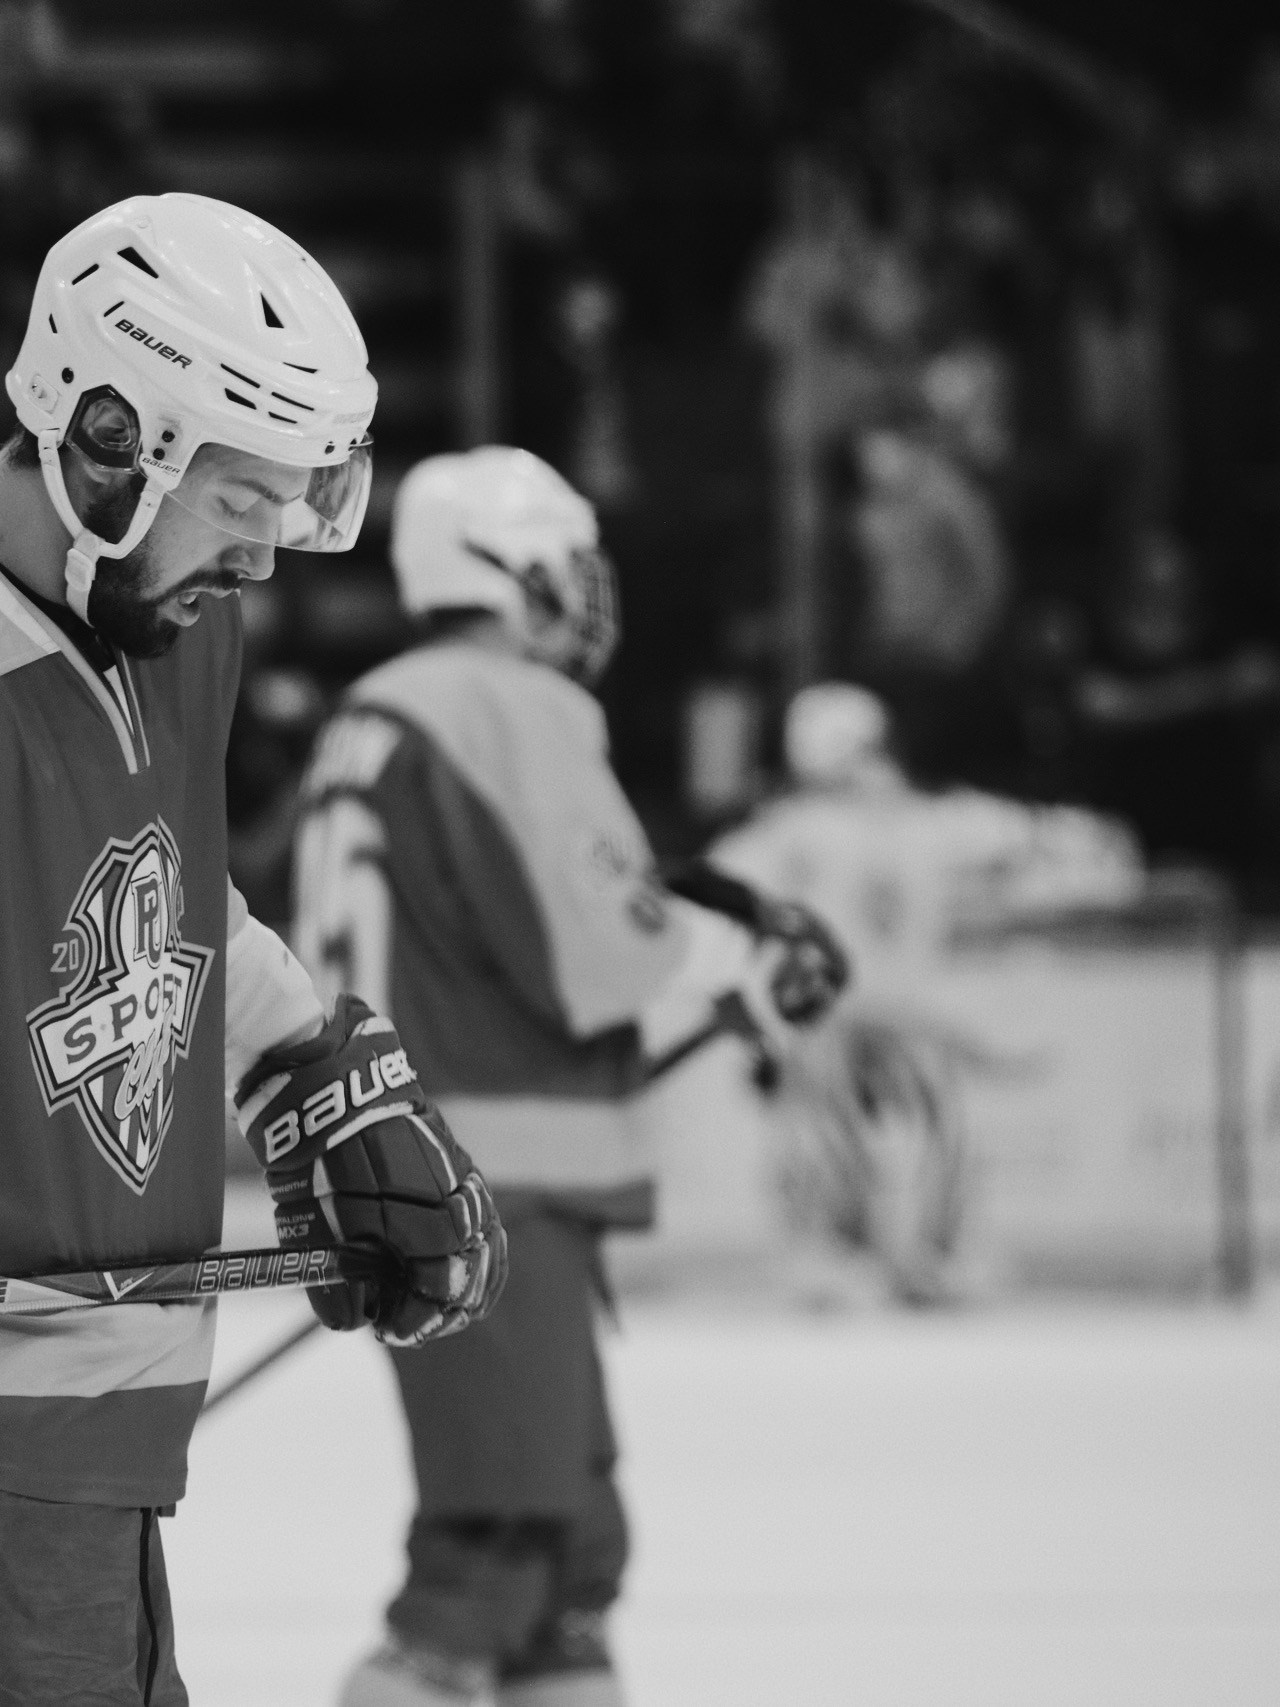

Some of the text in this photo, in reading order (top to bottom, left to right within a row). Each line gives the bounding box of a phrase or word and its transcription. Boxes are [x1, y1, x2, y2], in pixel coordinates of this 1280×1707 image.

[115, 319, 193, 370] BAUER
[50, 938, 79, 973] 20
[264, 1047, 418, 1165] BAUER
[278, 1223, 310, 1239] MX3
[194, 1249, 330, 1295] BAUER
